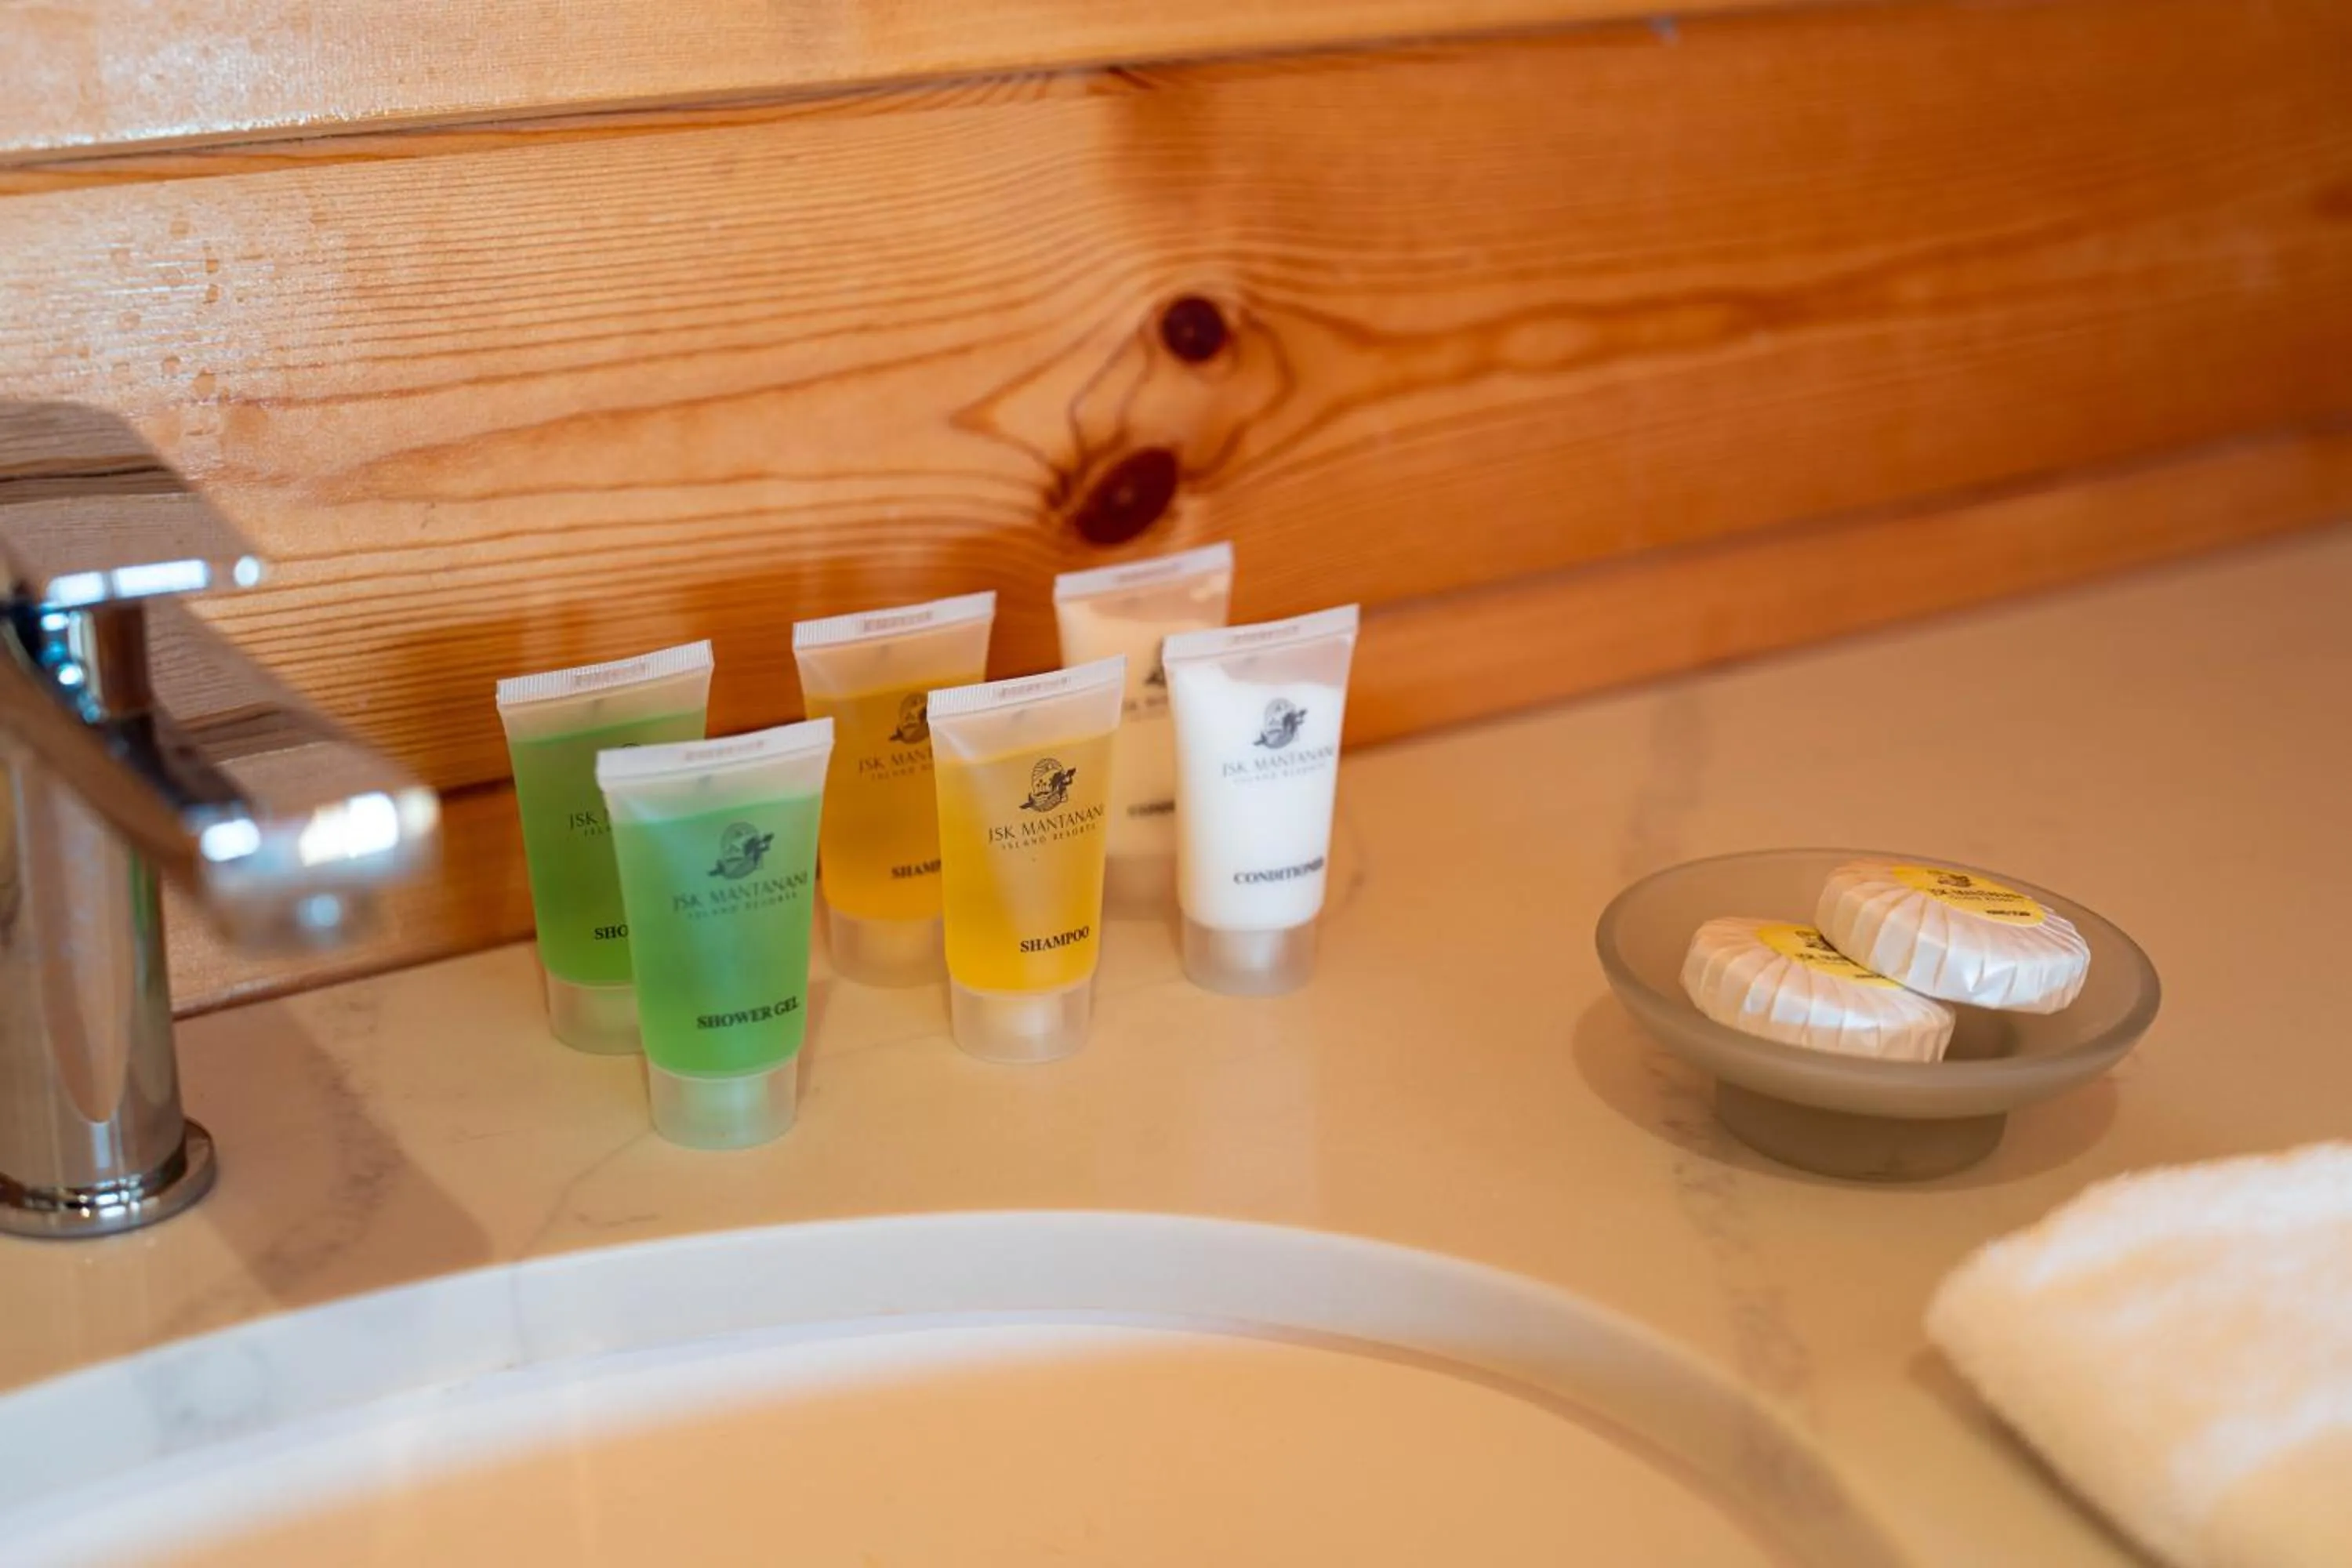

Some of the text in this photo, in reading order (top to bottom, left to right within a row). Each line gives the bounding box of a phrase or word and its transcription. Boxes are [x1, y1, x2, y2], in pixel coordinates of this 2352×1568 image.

[569, 811, 598, 831] JSK
[989, 826, 1014, 844] JSK
[594, 924, 629, 940] SHO
[1020, 925, 1090, 953] SHAMPOO
[697, 996, 800, 1029] SHOWER GEL
